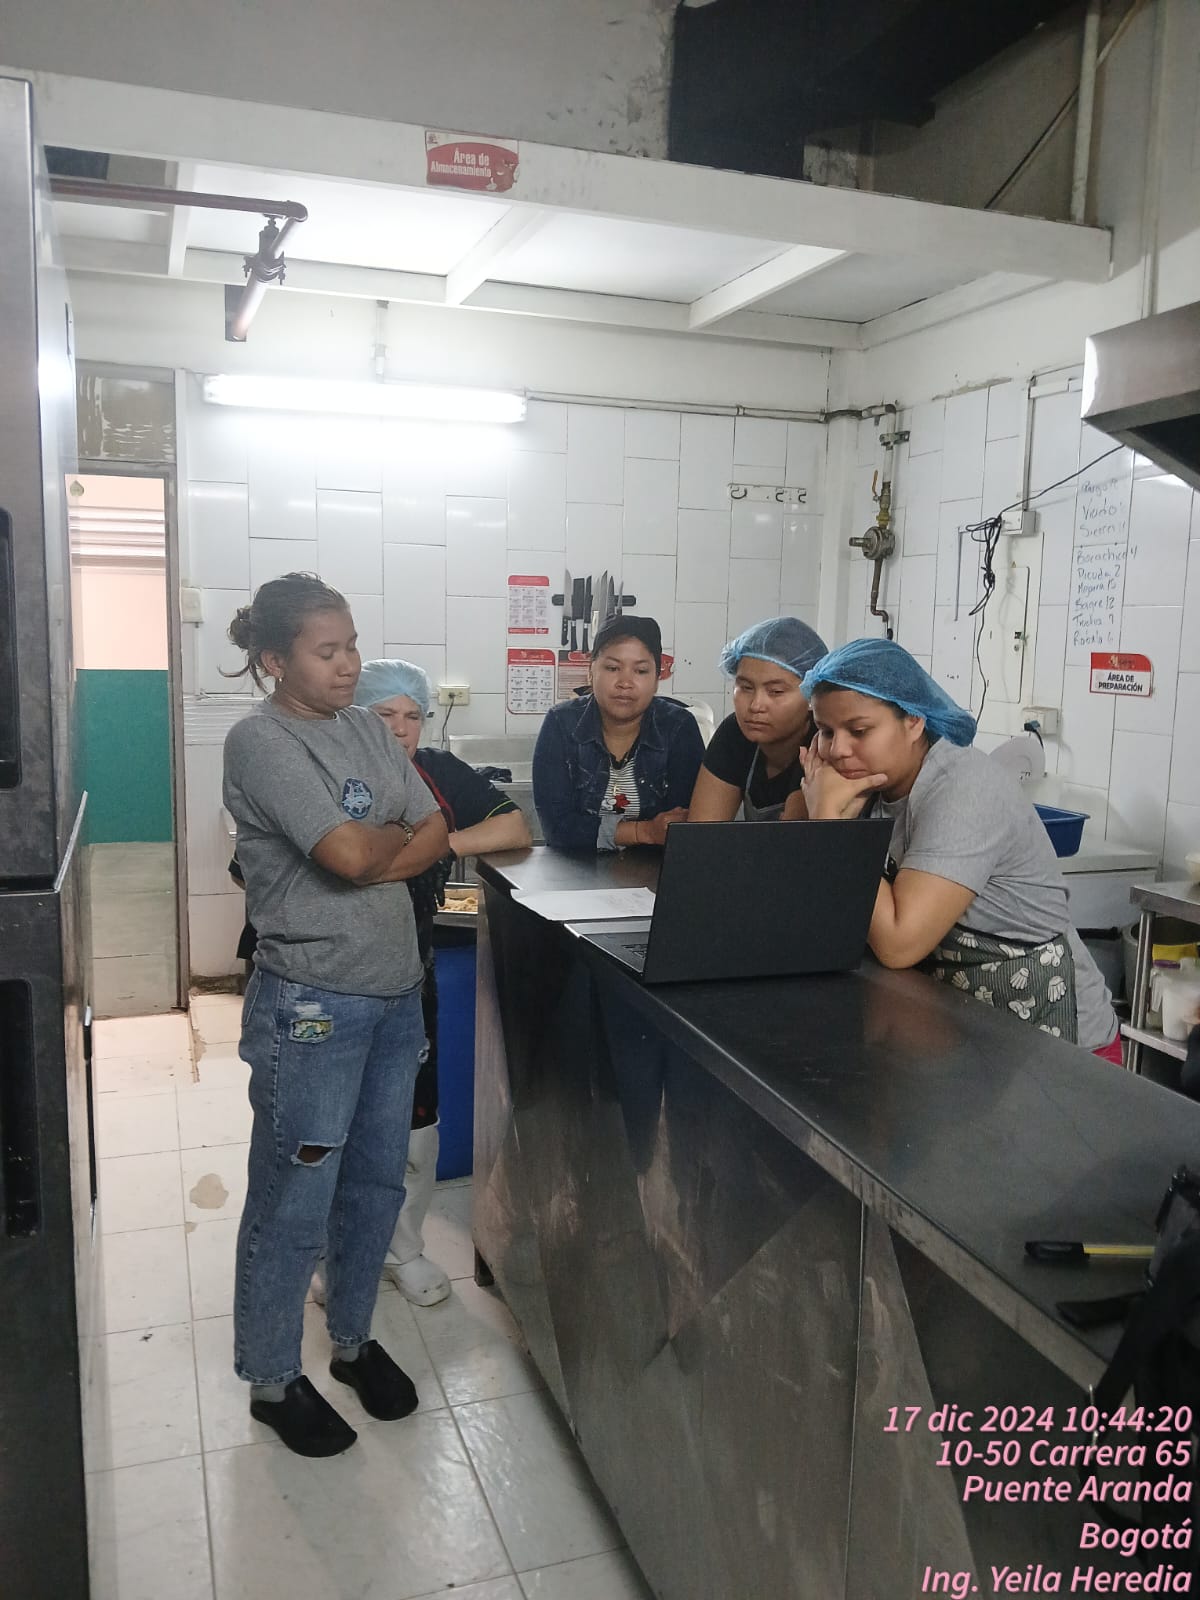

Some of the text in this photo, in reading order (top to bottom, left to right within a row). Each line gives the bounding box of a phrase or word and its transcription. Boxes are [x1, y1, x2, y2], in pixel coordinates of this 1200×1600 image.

[453, 147, 490, 166] Área de
[430, 160, 492, 178] Almacenamiento
[1107, 672, 1135, 683] ÁREA DE
[1098, 681, 1143, 692] PREPARACIÓN
